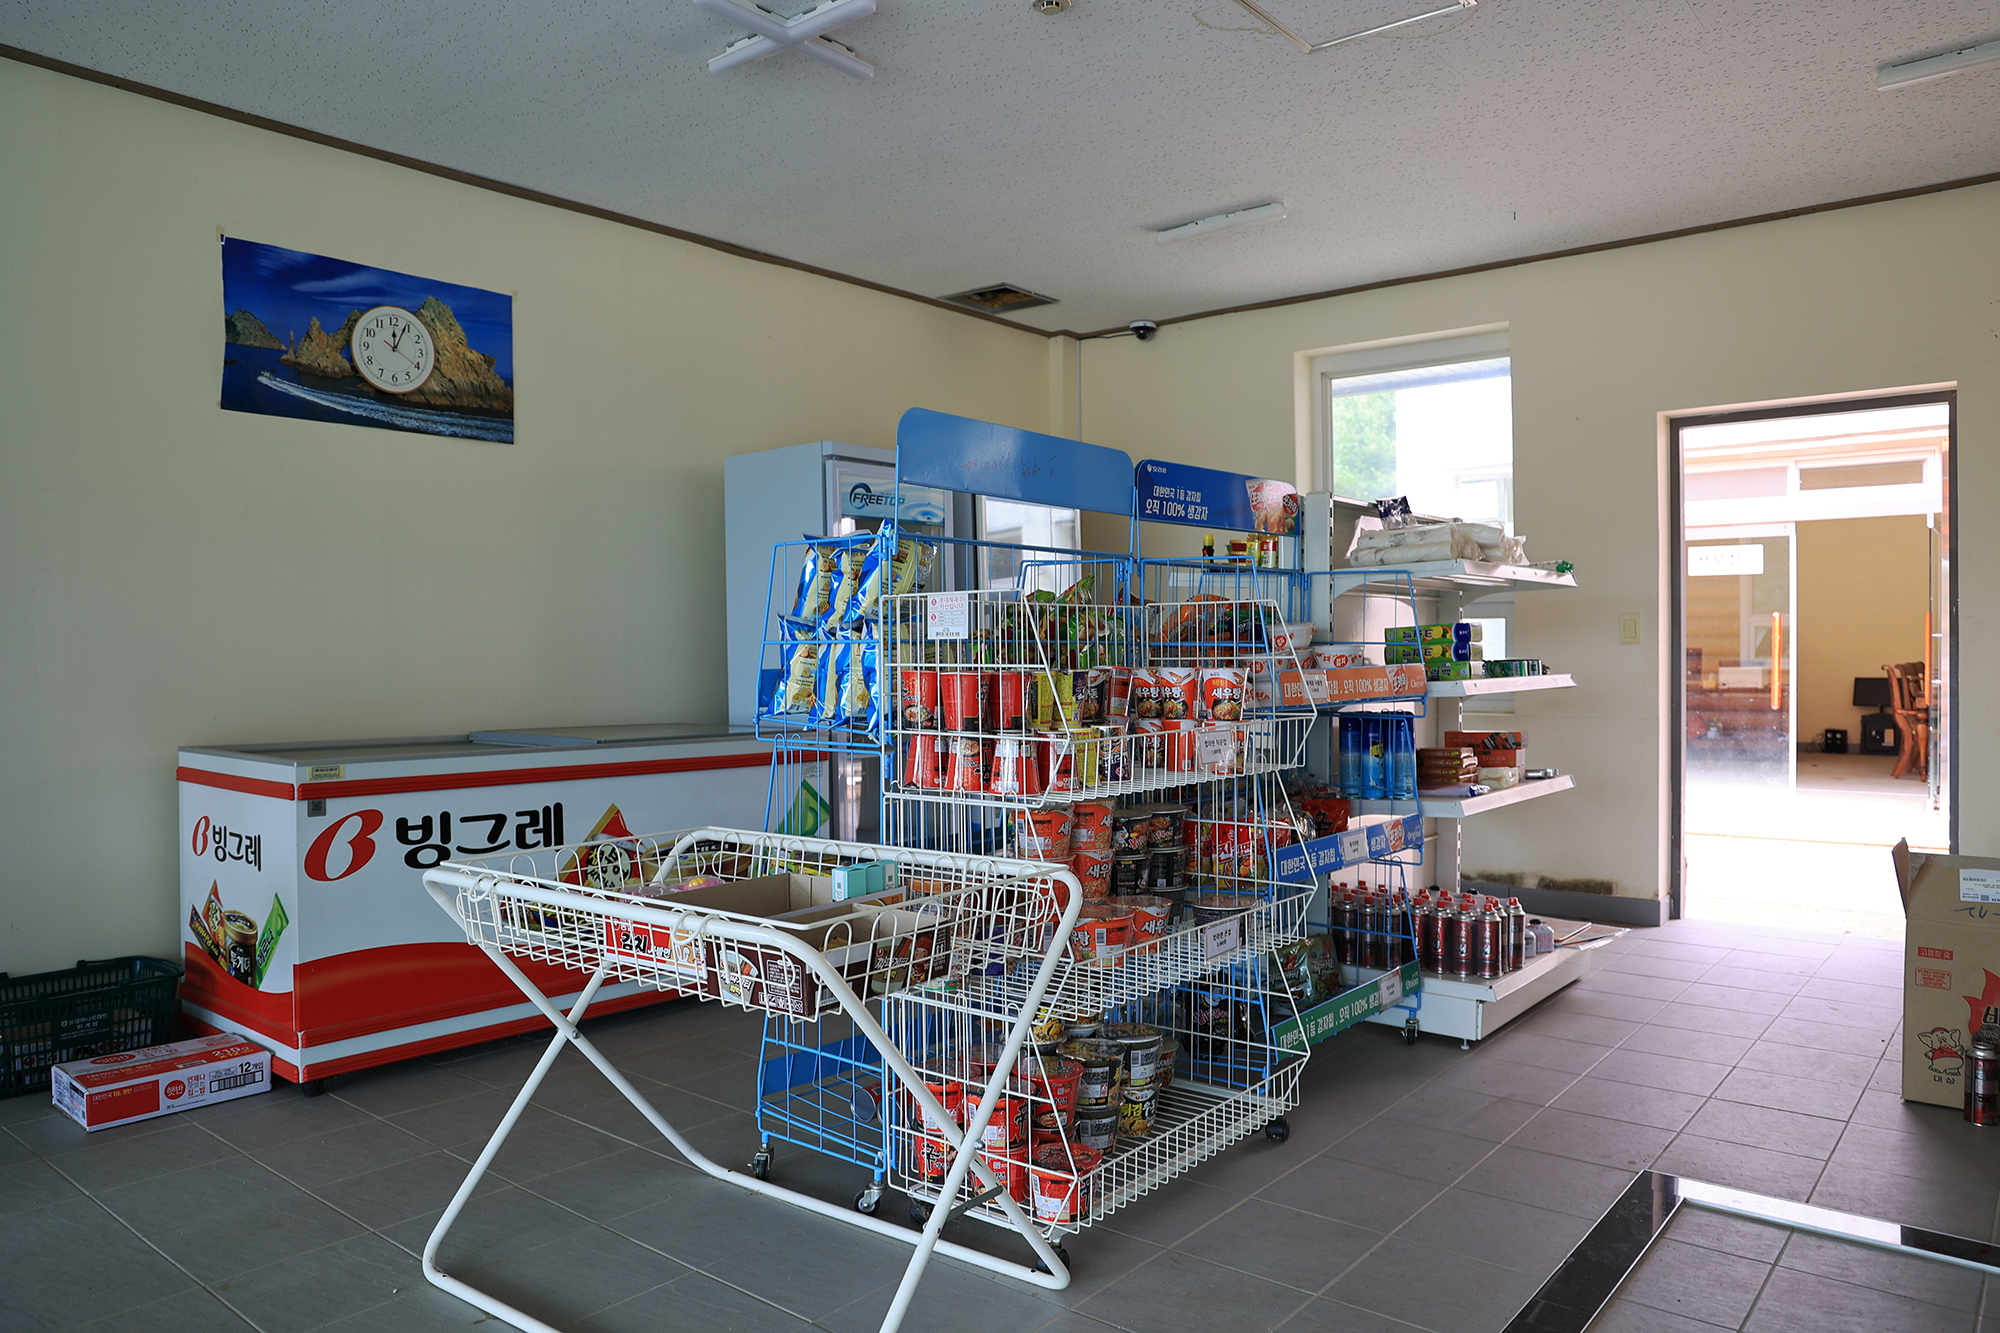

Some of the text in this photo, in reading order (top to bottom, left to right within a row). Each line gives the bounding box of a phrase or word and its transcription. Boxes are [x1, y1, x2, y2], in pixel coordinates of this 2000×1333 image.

[376, 318, 383, 329] 11
[389, 317, 399, 327] 12
[366, 328, 375, 338] 10
[415, 335, 420, 344] 2
[363, 341, 369, 351] 9
[366, 355, 372, 365] 8
[417, 349, 423, 358] 3
[378, 368, 384, 378] 7
[414, 362, 420, 371] 4
[391, 373, 398, 383] 6
[404, 371, 411, 381] 5
[852, 492, 906, 507] FREETOP
[1153, 485, 1175, 499] 대한민국
[1186, 490, 1202, 503] 감자칩
[1145, 498, 1209, 521] 오직 100% 생감자
[1344, 679, 1354, 693] 오직
[1356, 678, 1372, 693] 100%
[1373, 677, 1389, 692] 생감자
[395, 801, 564, 870] 빙그레
[212, 824, 262, 873] 빙그레
[1371, 834, 1387, 852] 생감자
[1280, 855, 1306, 876] 대한민국
[621, 932, 648, 954] 김치
[1072, 929, 1091, 947] 우탕
[1406, 977, 1420, 990] Onion
[1280, 1027, 1304, 1050] 대한민국
[1339, 1006, 1350, 1023] 오직
[1351, 999, 1368, 1017] 100%
[187, 1074, 206, 1084] 언제나
[166, 1083, 184, 1097] 햇반
[920, 1142, 941, 1172] 辛
